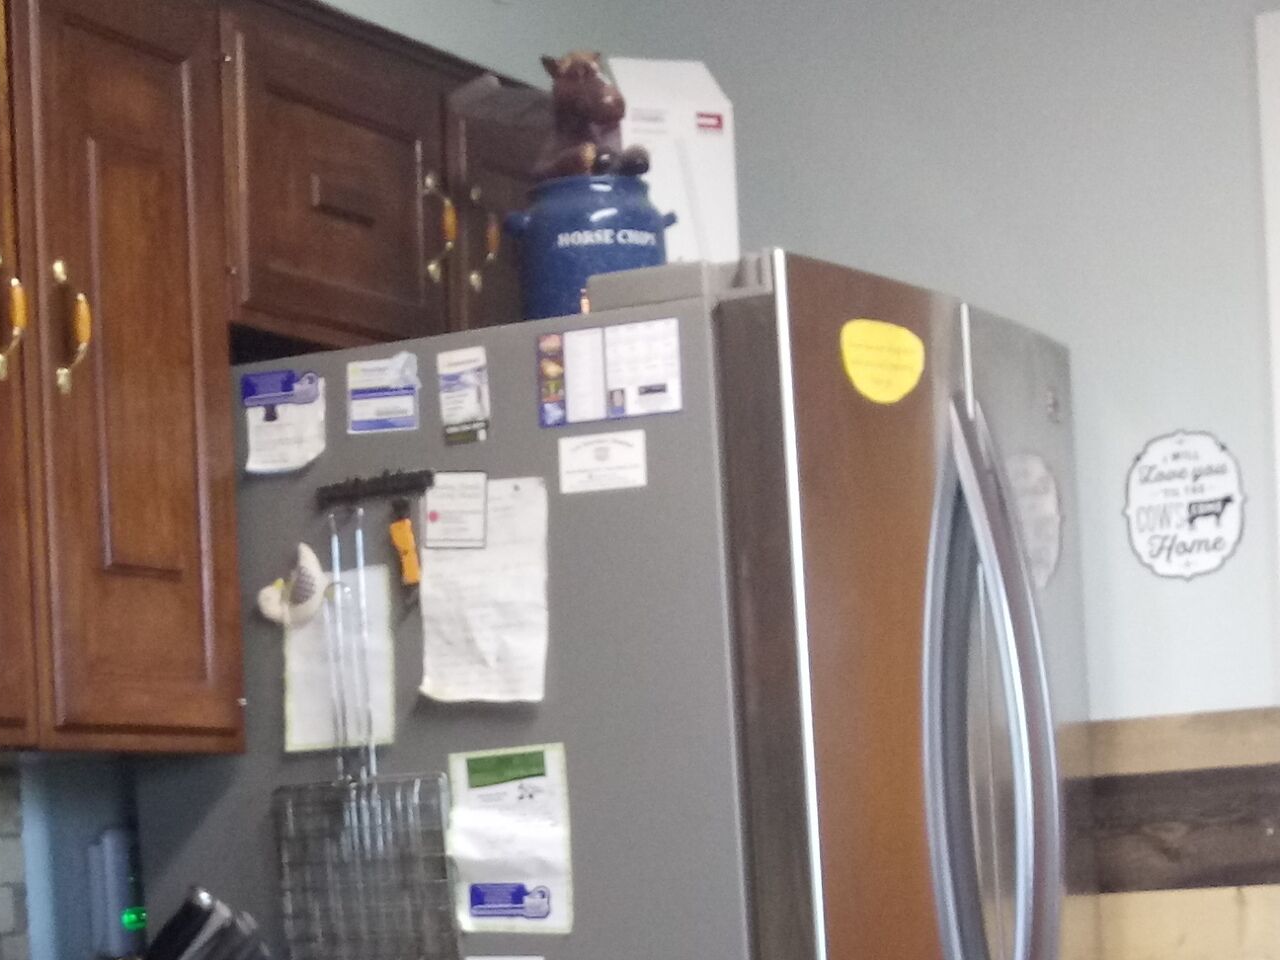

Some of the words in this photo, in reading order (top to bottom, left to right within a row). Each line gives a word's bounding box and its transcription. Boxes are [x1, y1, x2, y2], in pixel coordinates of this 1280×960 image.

[557, 229, 614, 248] HORSE
[1138, 464, 1187, 484] Love
[1192, 463, 1228, 482] you
[1149, 534, 1225, 562] Home
